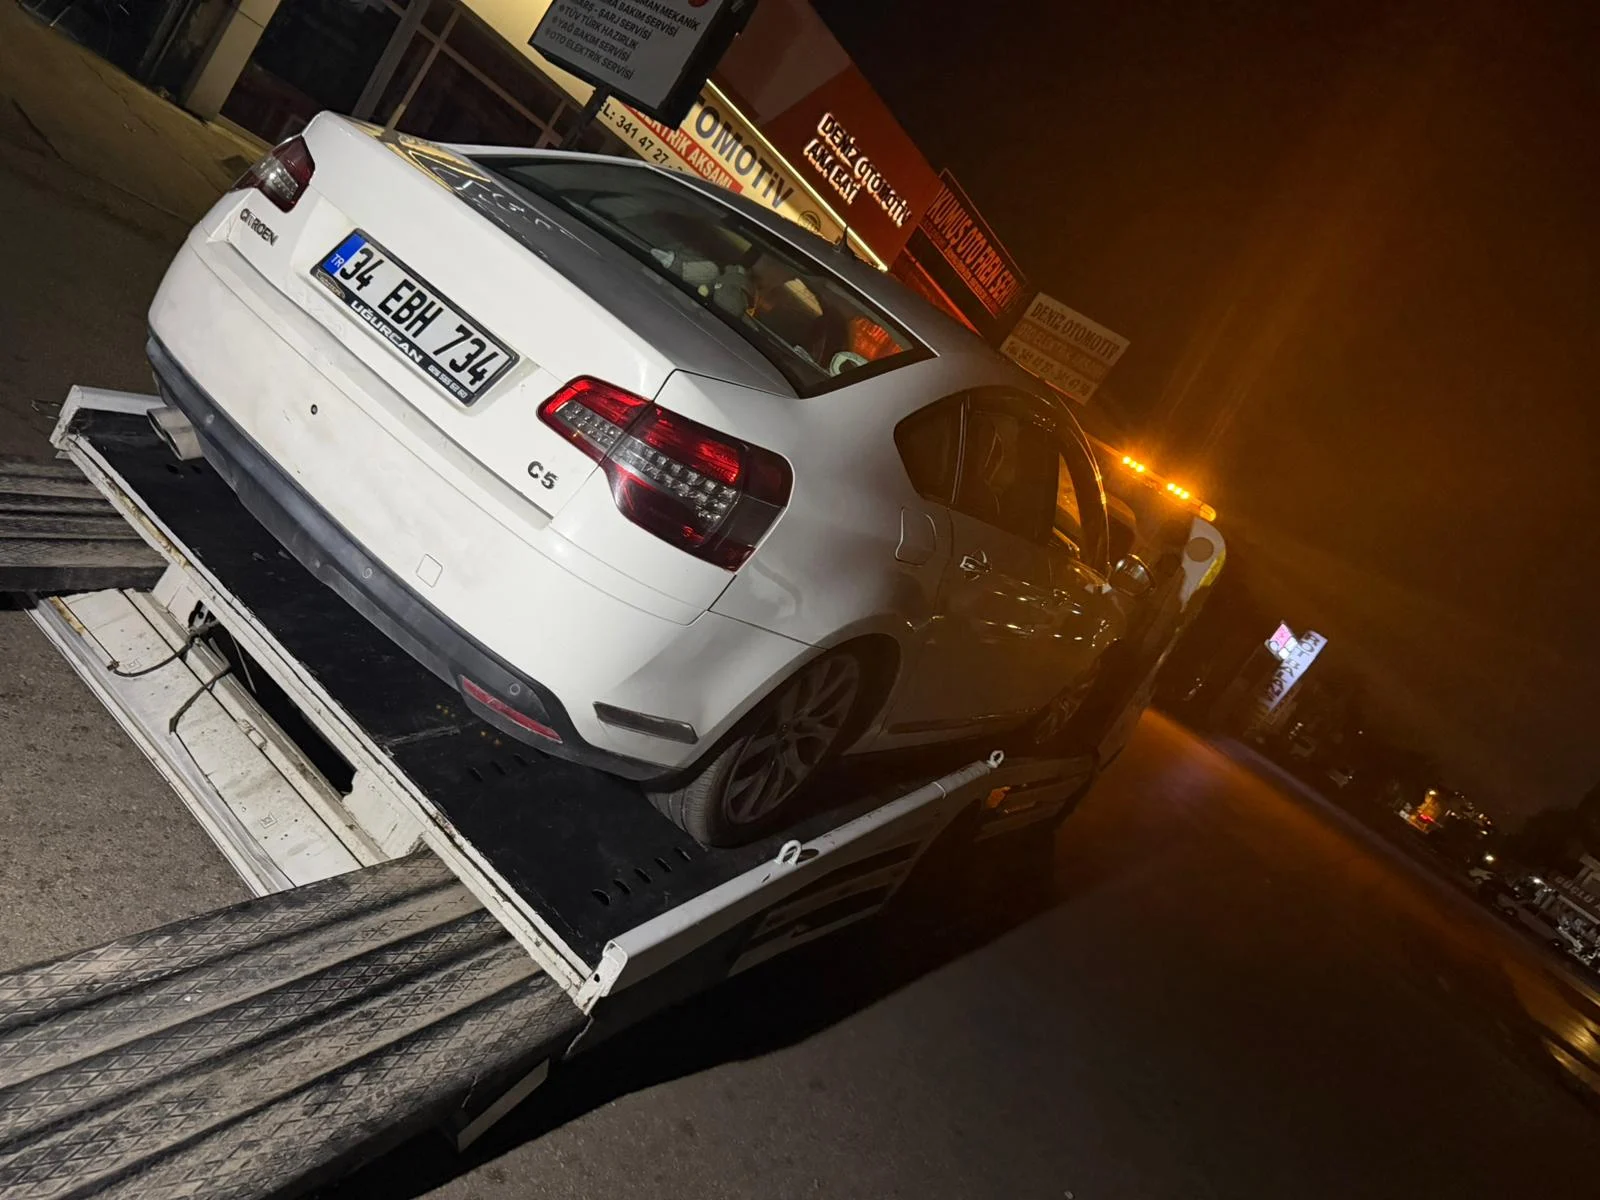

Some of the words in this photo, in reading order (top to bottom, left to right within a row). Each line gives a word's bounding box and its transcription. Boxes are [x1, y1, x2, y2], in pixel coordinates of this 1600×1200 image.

[618, 1, 646, 21] BAKIM
[644, 15, 680, 37] SERVİSİ
[619, 18, 653, 40] SERVİSİ
[660, 6, 700, 31] MEKANİK
[598, 39, 632, 62] SERVİSİ
[600, 57, 635, 80] SERVİSİ
[616, 115, 639, 139] 341
[638, 136, 655, 151] 47
[652, 148, 669, 164] 27
[816, 112, 858, 168] DENİZ
[854, 155, 913, 229] OTOMOTİV
[331, 253, 345, 269] TR
[954, 225, 988, 265] OTO
[339, 247, 384, 291] 34
[377, 278, 444, 338] EBH
[433, 324, 500, 388] 734
[350, 299, 423, 364] UĞURCAN
[527, 460, 559, 490] C5
